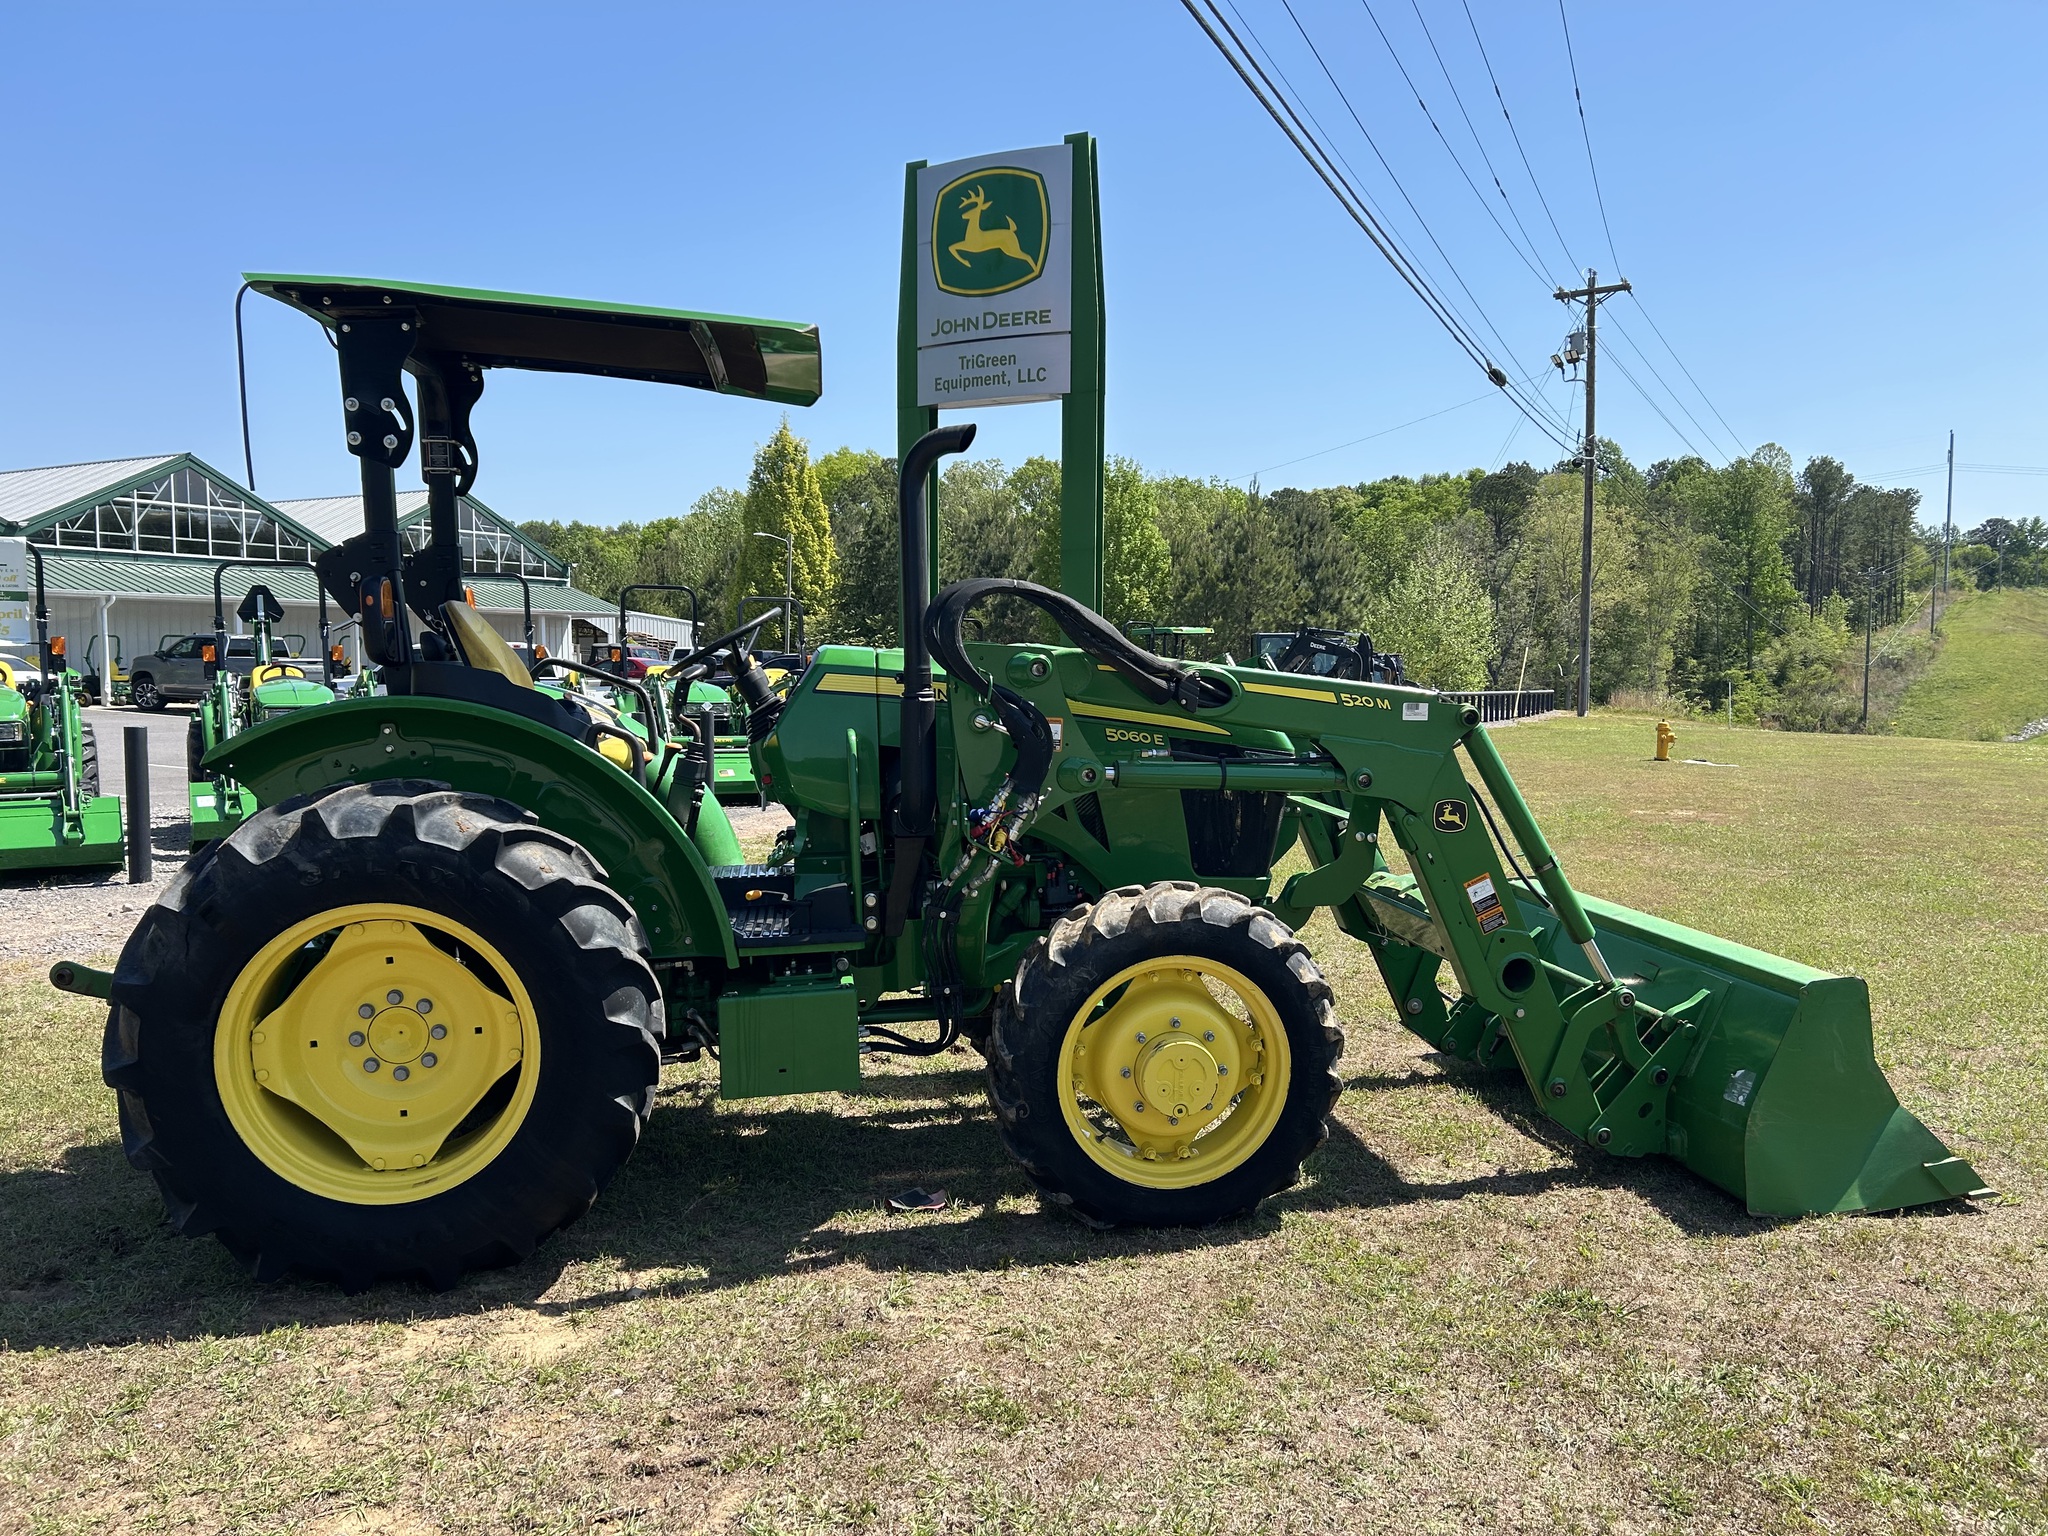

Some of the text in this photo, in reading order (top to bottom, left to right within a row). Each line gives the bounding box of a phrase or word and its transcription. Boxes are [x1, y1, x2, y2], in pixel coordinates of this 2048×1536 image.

[931, 309, 1051, 337] JOHN DEERE
[959, 354, 1017, 371] TriGreen
[934, 367, 1047, 393] Equipment, LLC
[1340, 692, 1391, 710] 520 M
[1105, 727, 1165, 746] 5060 E
